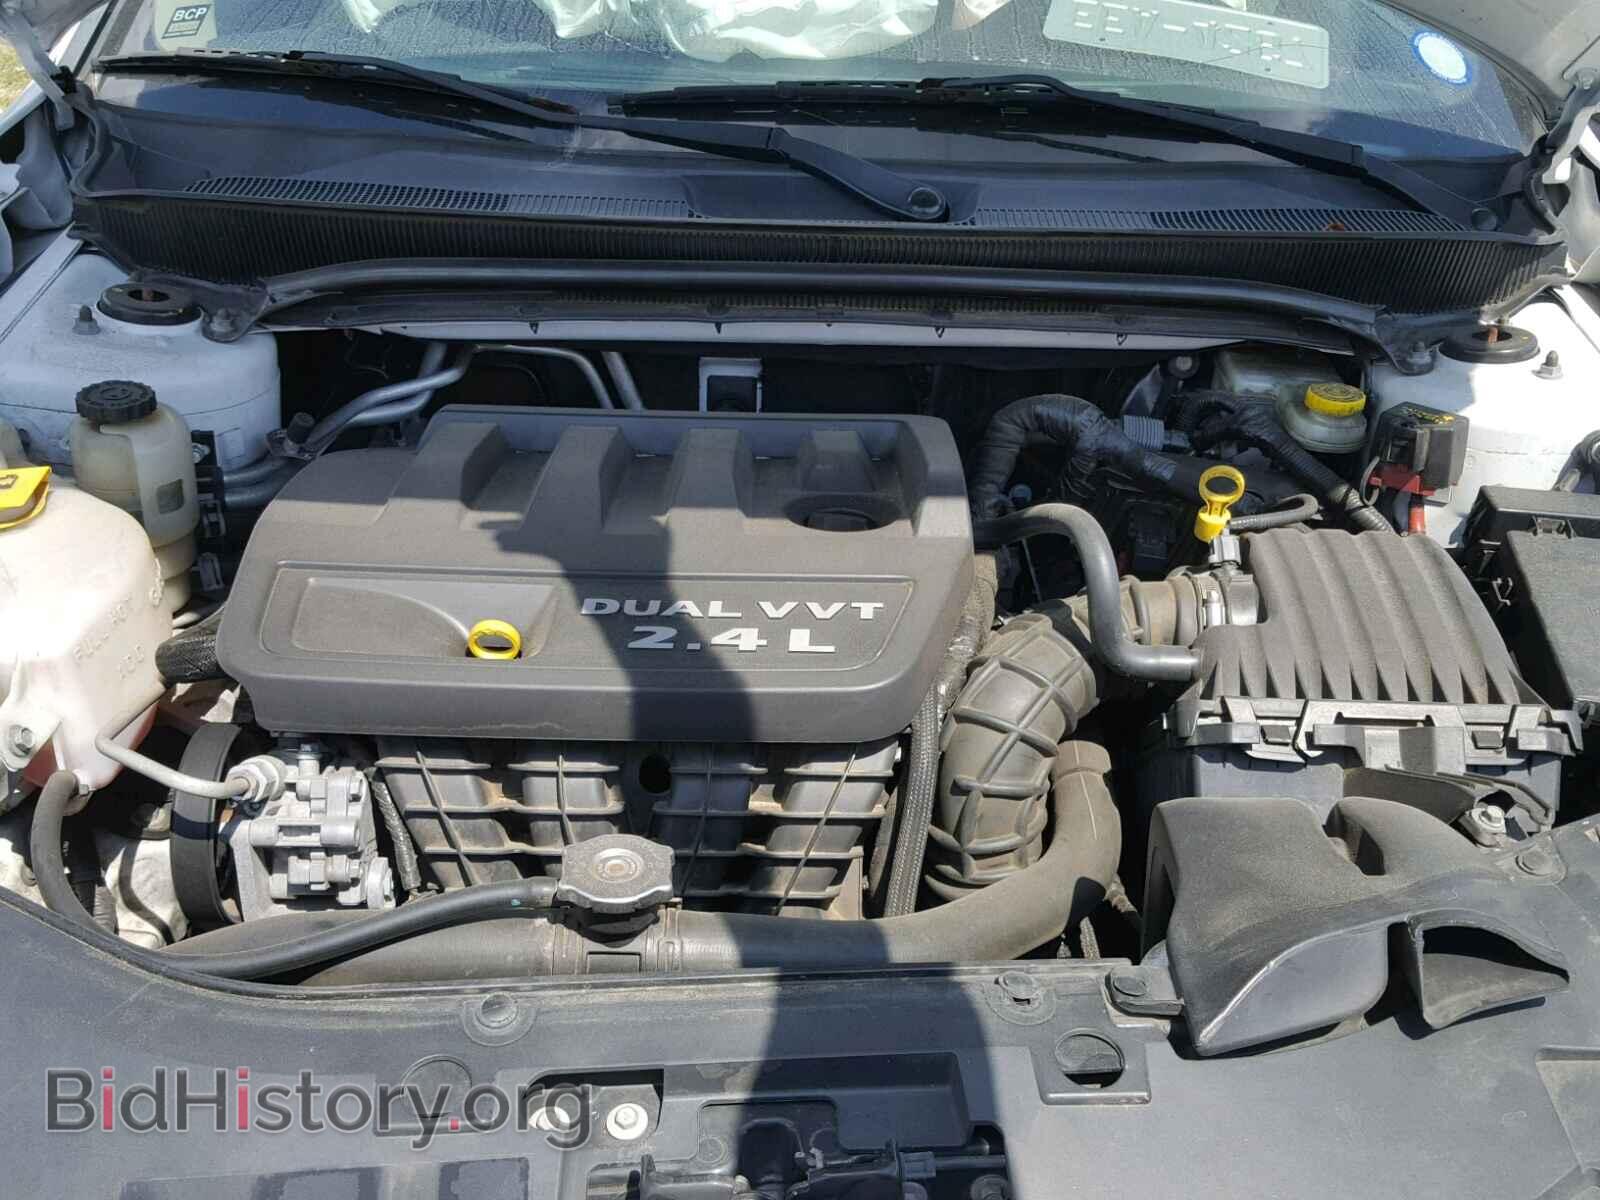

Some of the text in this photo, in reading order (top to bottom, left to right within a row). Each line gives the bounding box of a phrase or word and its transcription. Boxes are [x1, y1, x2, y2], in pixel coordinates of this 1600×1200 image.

[173, 7, 207, 21] BCP
[581, 598, 884, 620] DUAL VVT
